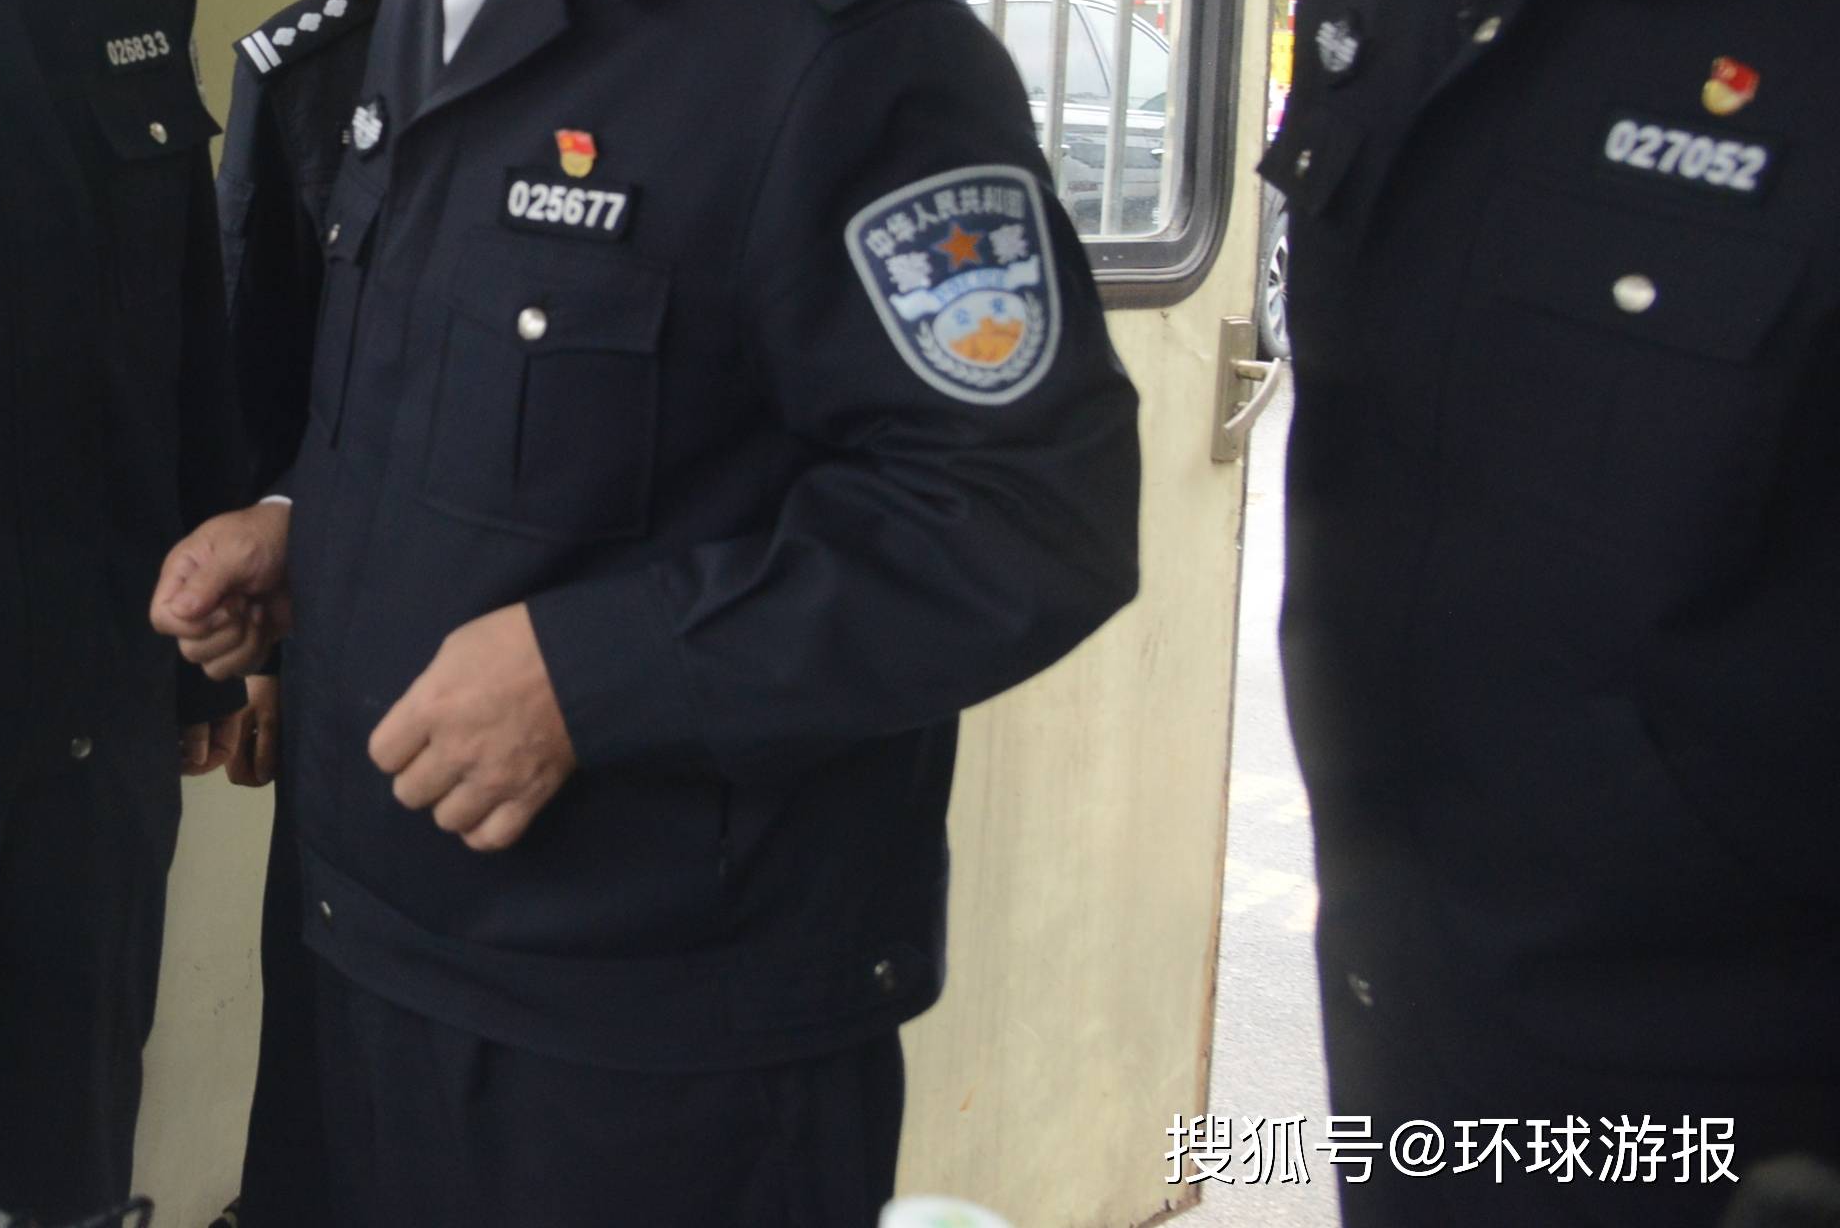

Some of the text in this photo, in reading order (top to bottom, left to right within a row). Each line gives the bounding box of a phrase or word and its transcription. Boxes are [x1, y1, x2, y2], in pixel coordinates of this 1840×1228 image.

[105, 30, 170, 66] 026833
[1604, 118, 1767, 192] 027052
[507, 179, 627, 231] 025677
[865, 185, 1025, 259] 中华人民共和国
